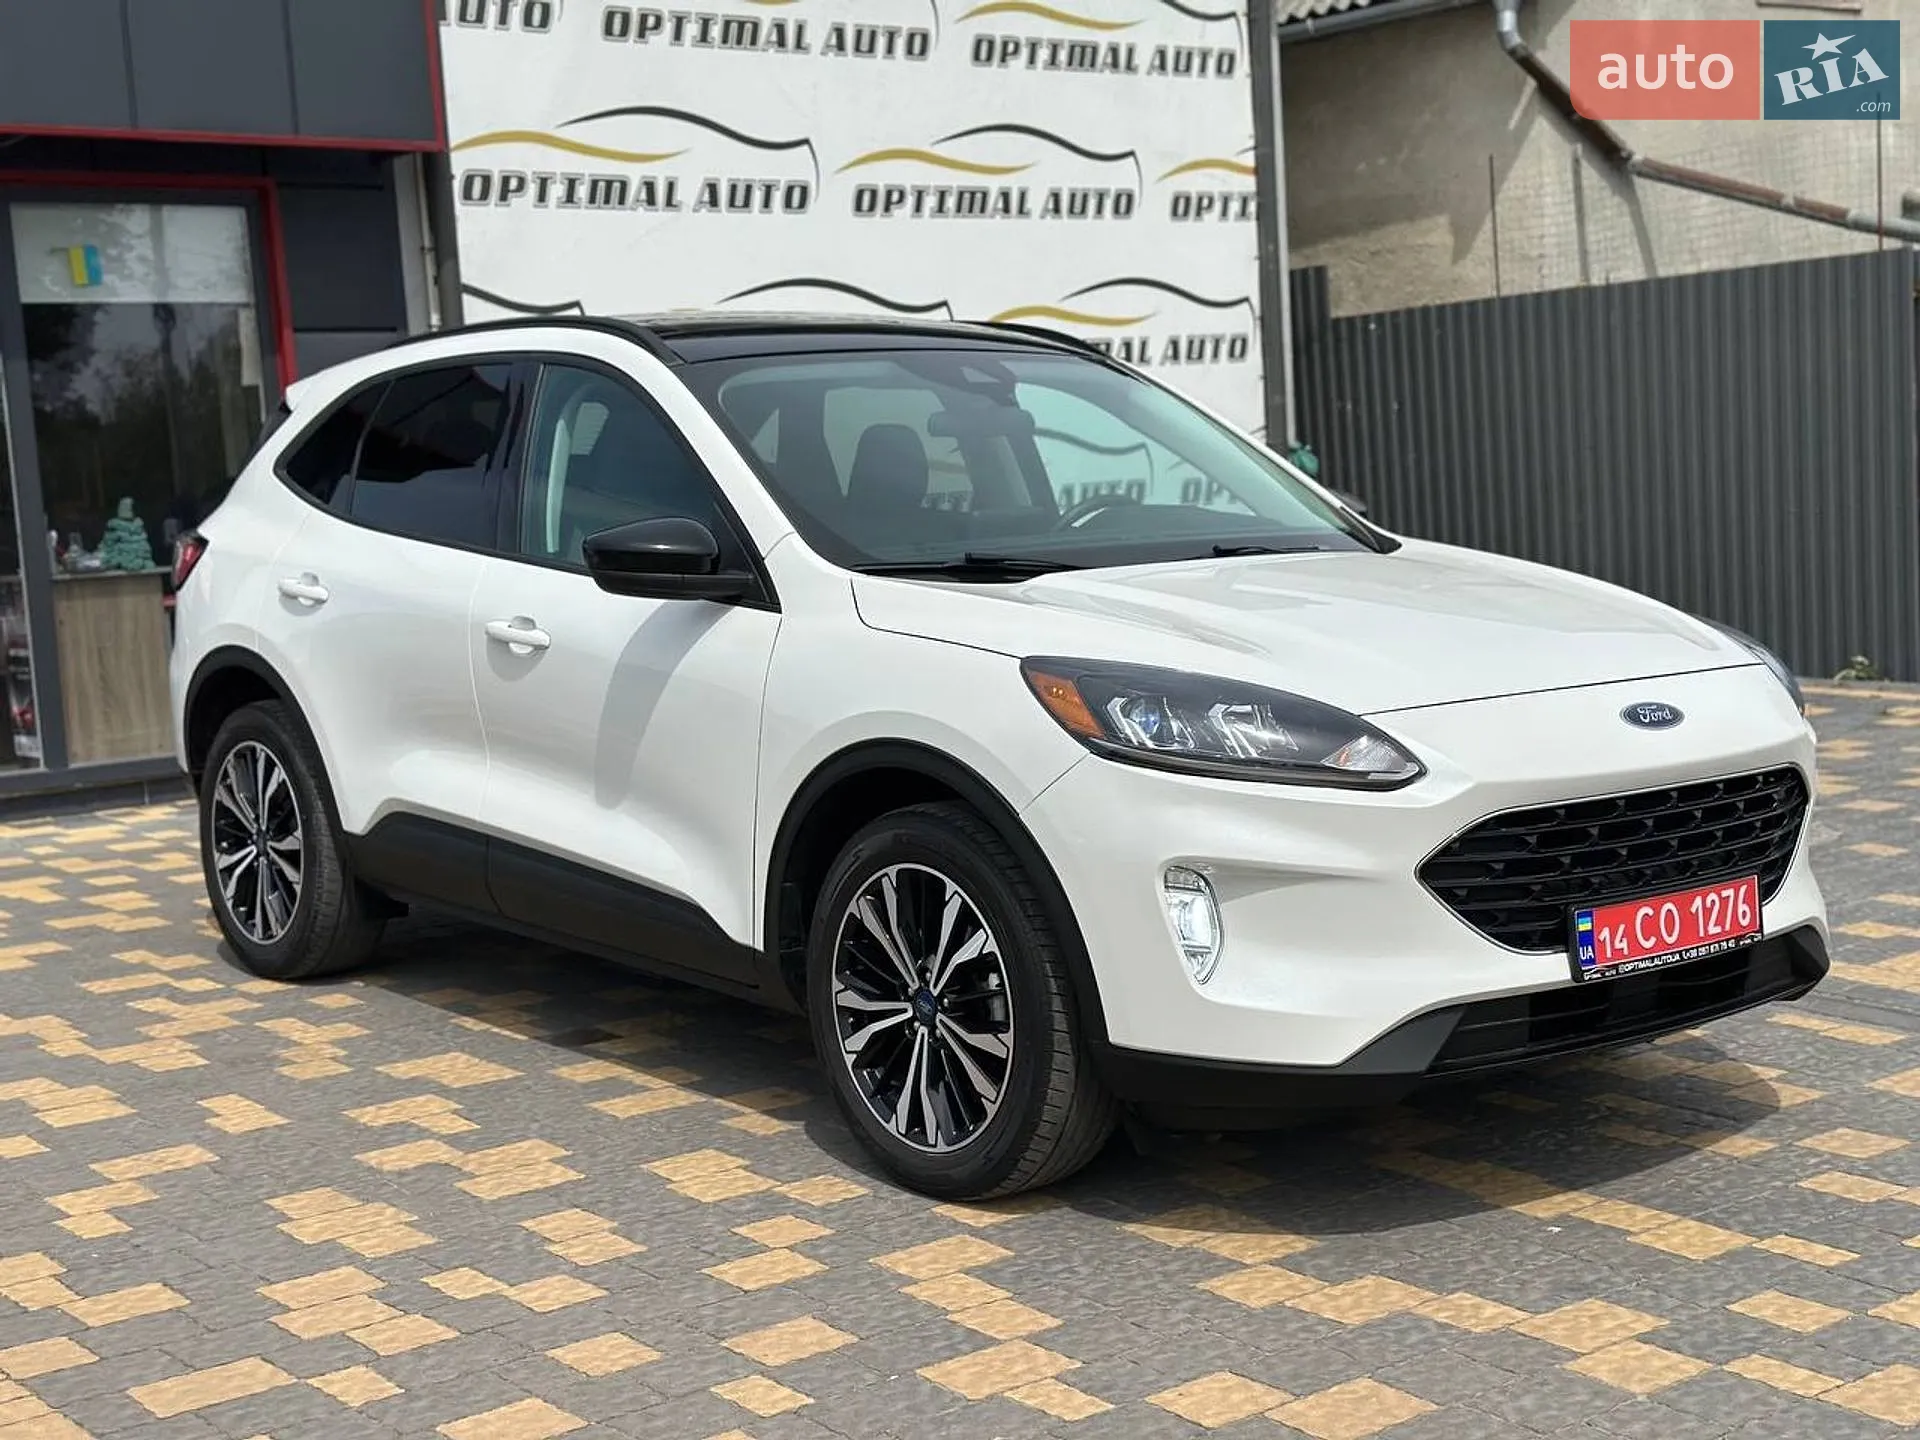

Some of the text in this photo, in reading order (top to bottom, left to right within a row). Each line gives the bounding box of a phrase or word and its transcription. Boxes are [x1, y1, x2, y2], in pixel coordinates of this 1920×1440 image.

[600, 5, 931, 61] OPTIMAL AUTO
[971, 33, 1237, 79] OPTIMAL AUTO
[459, 168, 811, 214] OPTIMAL AUTO
[851, 184, 1137, 220] OPTIMAL AUTO
[1170, 191, 1257, 222] OPTI
[1159, 333, 1248, 366] AUTO
[1637, 705, 1673, 722] Ford
[1598, 884, 1751, 958] 14 CO 1276
[1580, 945, 1594, 960] UA
